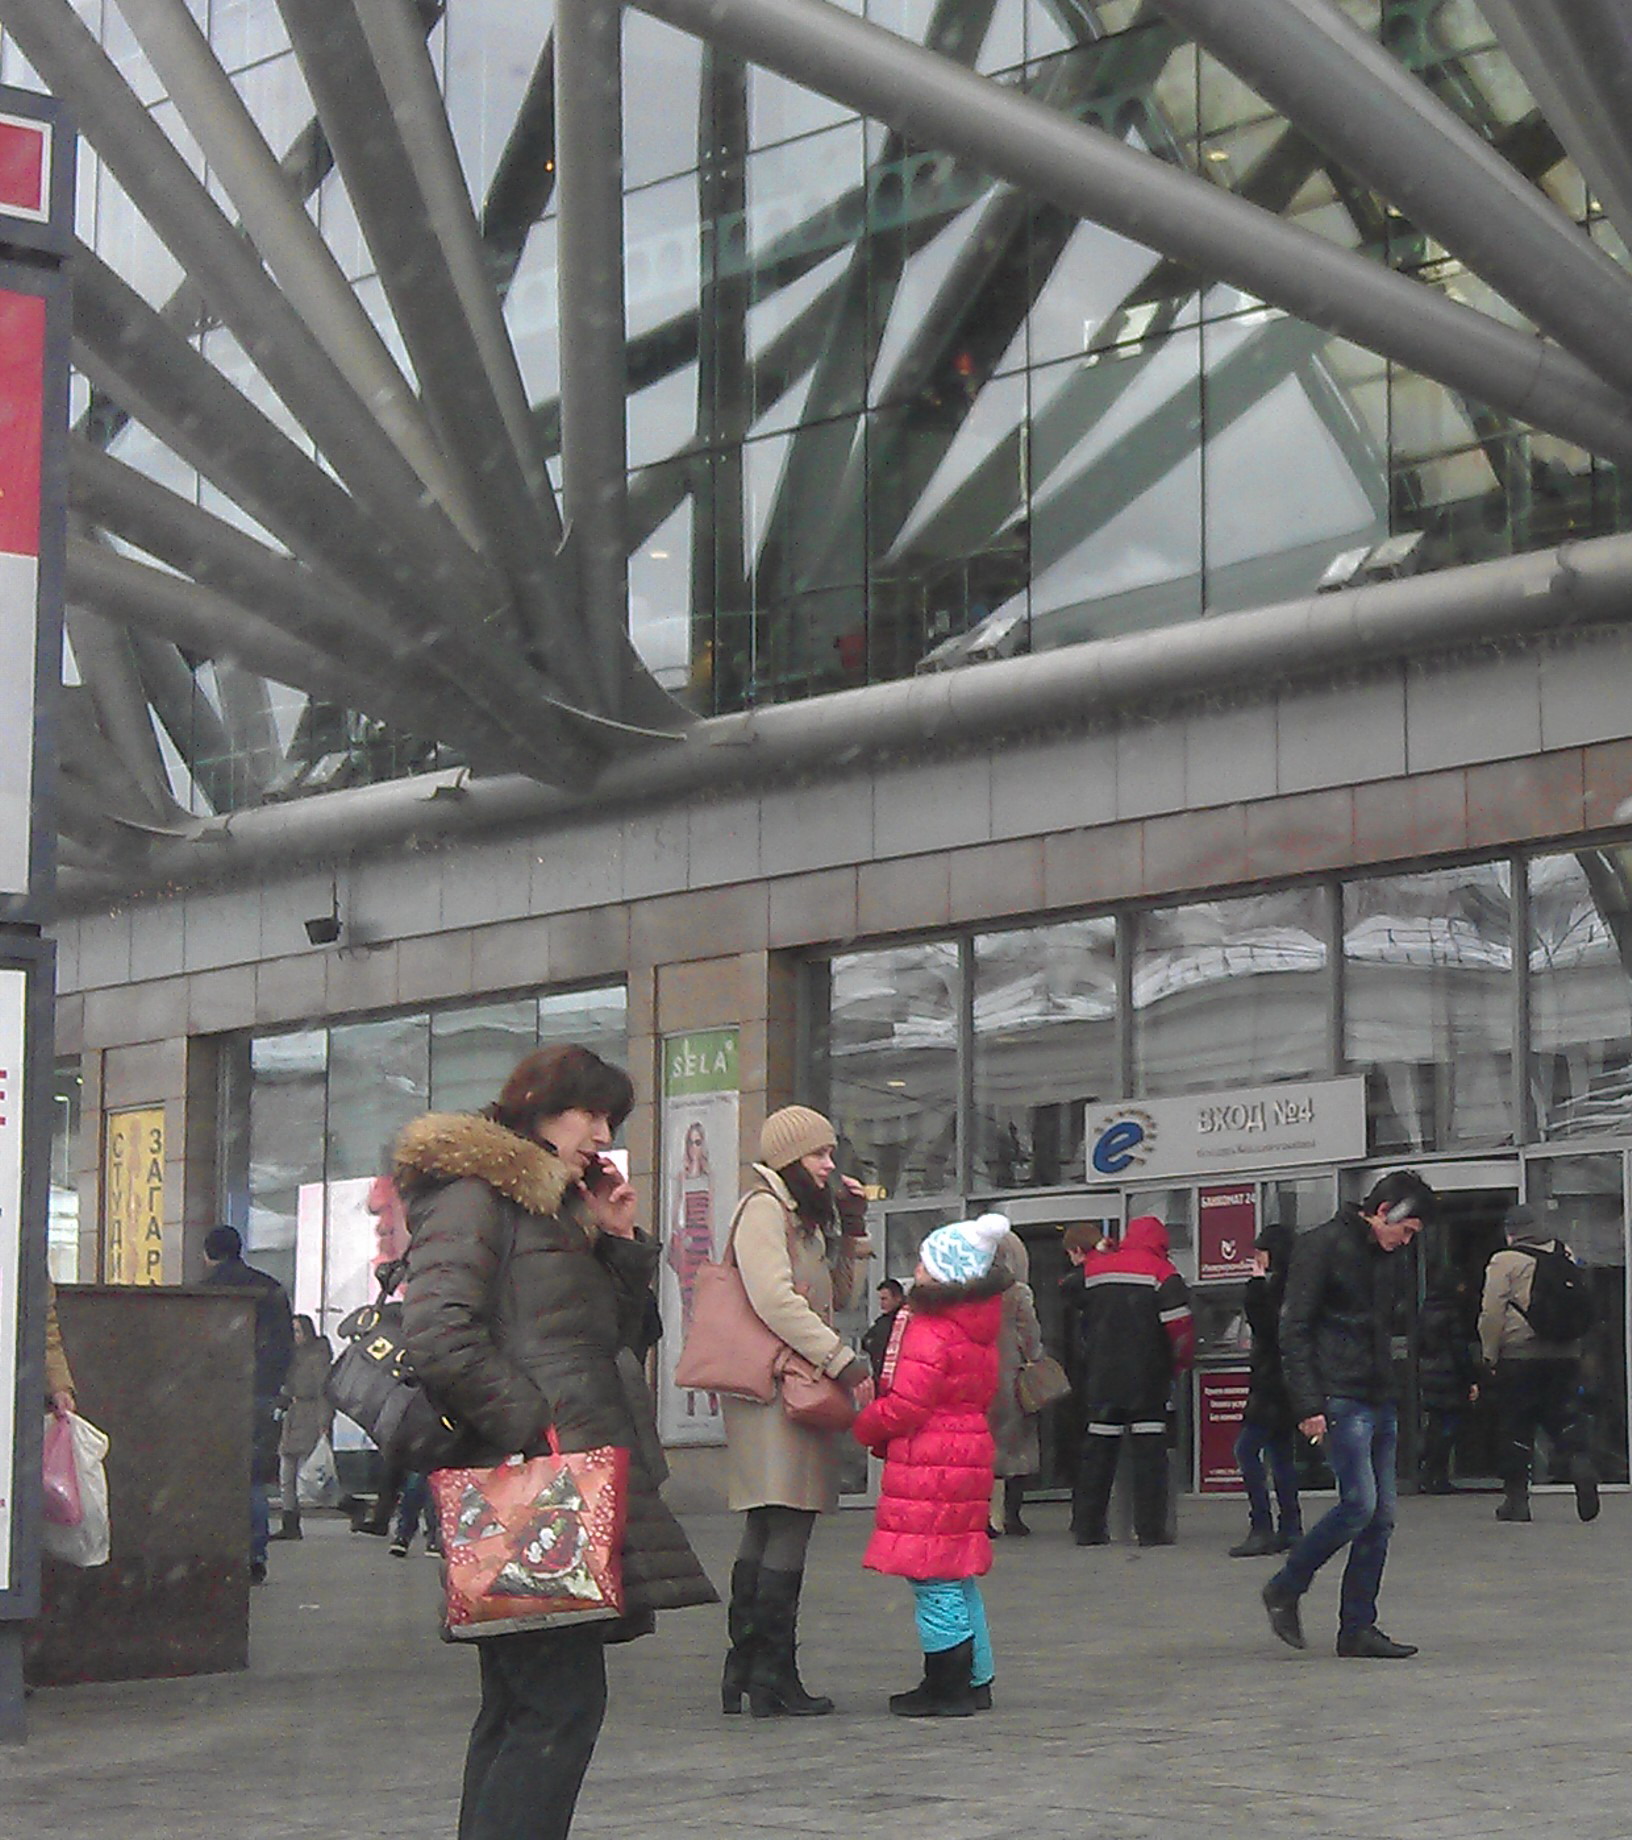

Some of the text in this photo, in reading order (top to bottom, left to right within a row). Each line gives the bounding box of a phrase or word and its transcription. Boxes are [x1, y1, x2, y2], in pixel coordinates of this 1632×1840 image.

[673, 1040, 727, 1077] SELA
[1198, 1097, 1314, 1134] ВХОД №4
[146, 1128, 162, 1284] ЗАГАР
